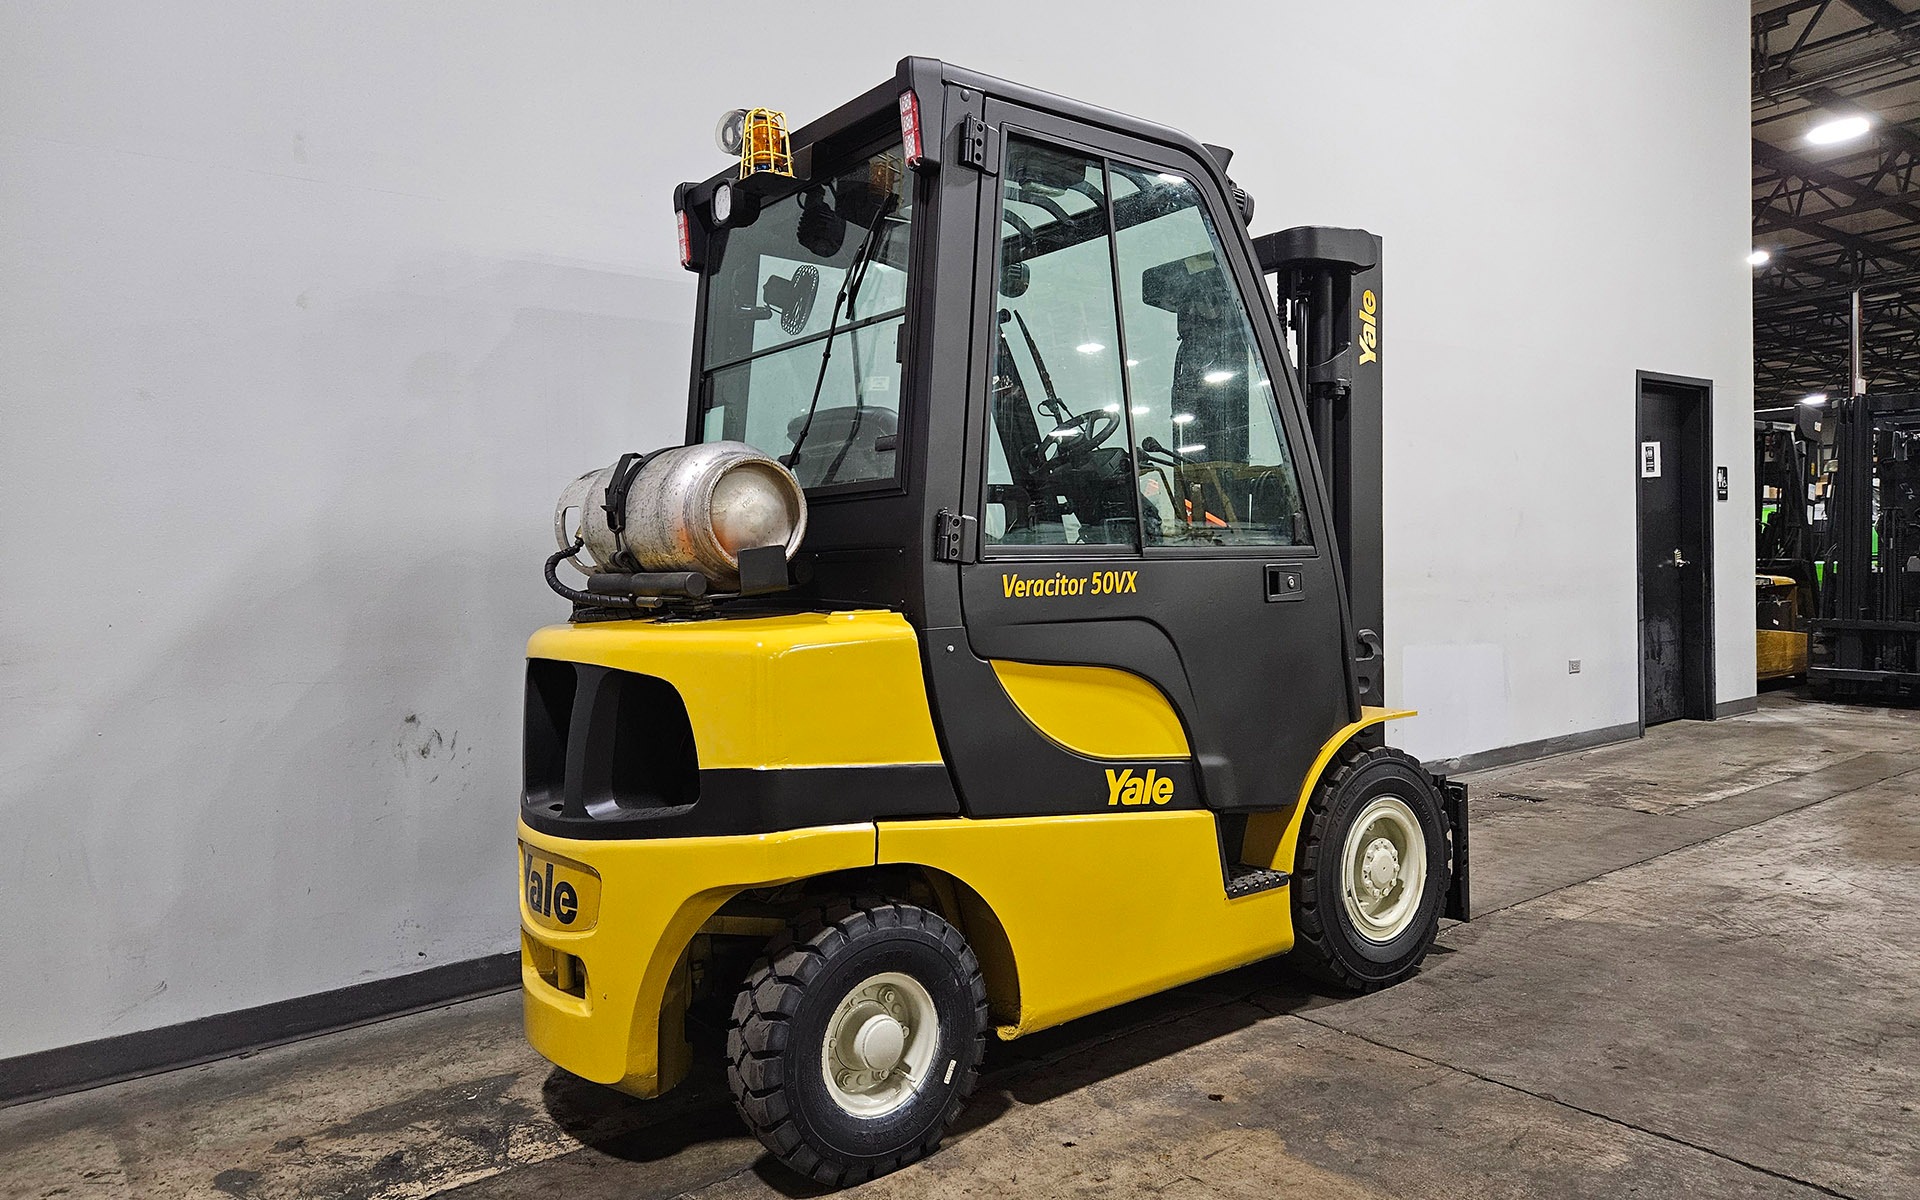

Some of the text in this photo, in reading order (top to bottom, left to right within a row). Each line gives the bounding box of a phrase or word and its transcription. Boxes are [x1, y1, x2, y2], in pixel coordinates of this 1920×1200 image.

[1359, 289, 1377, 366] Yale
[1002, 570, 1138, 598] Veracitor 50VX
[1105, 769, 1175, 806] Yale
